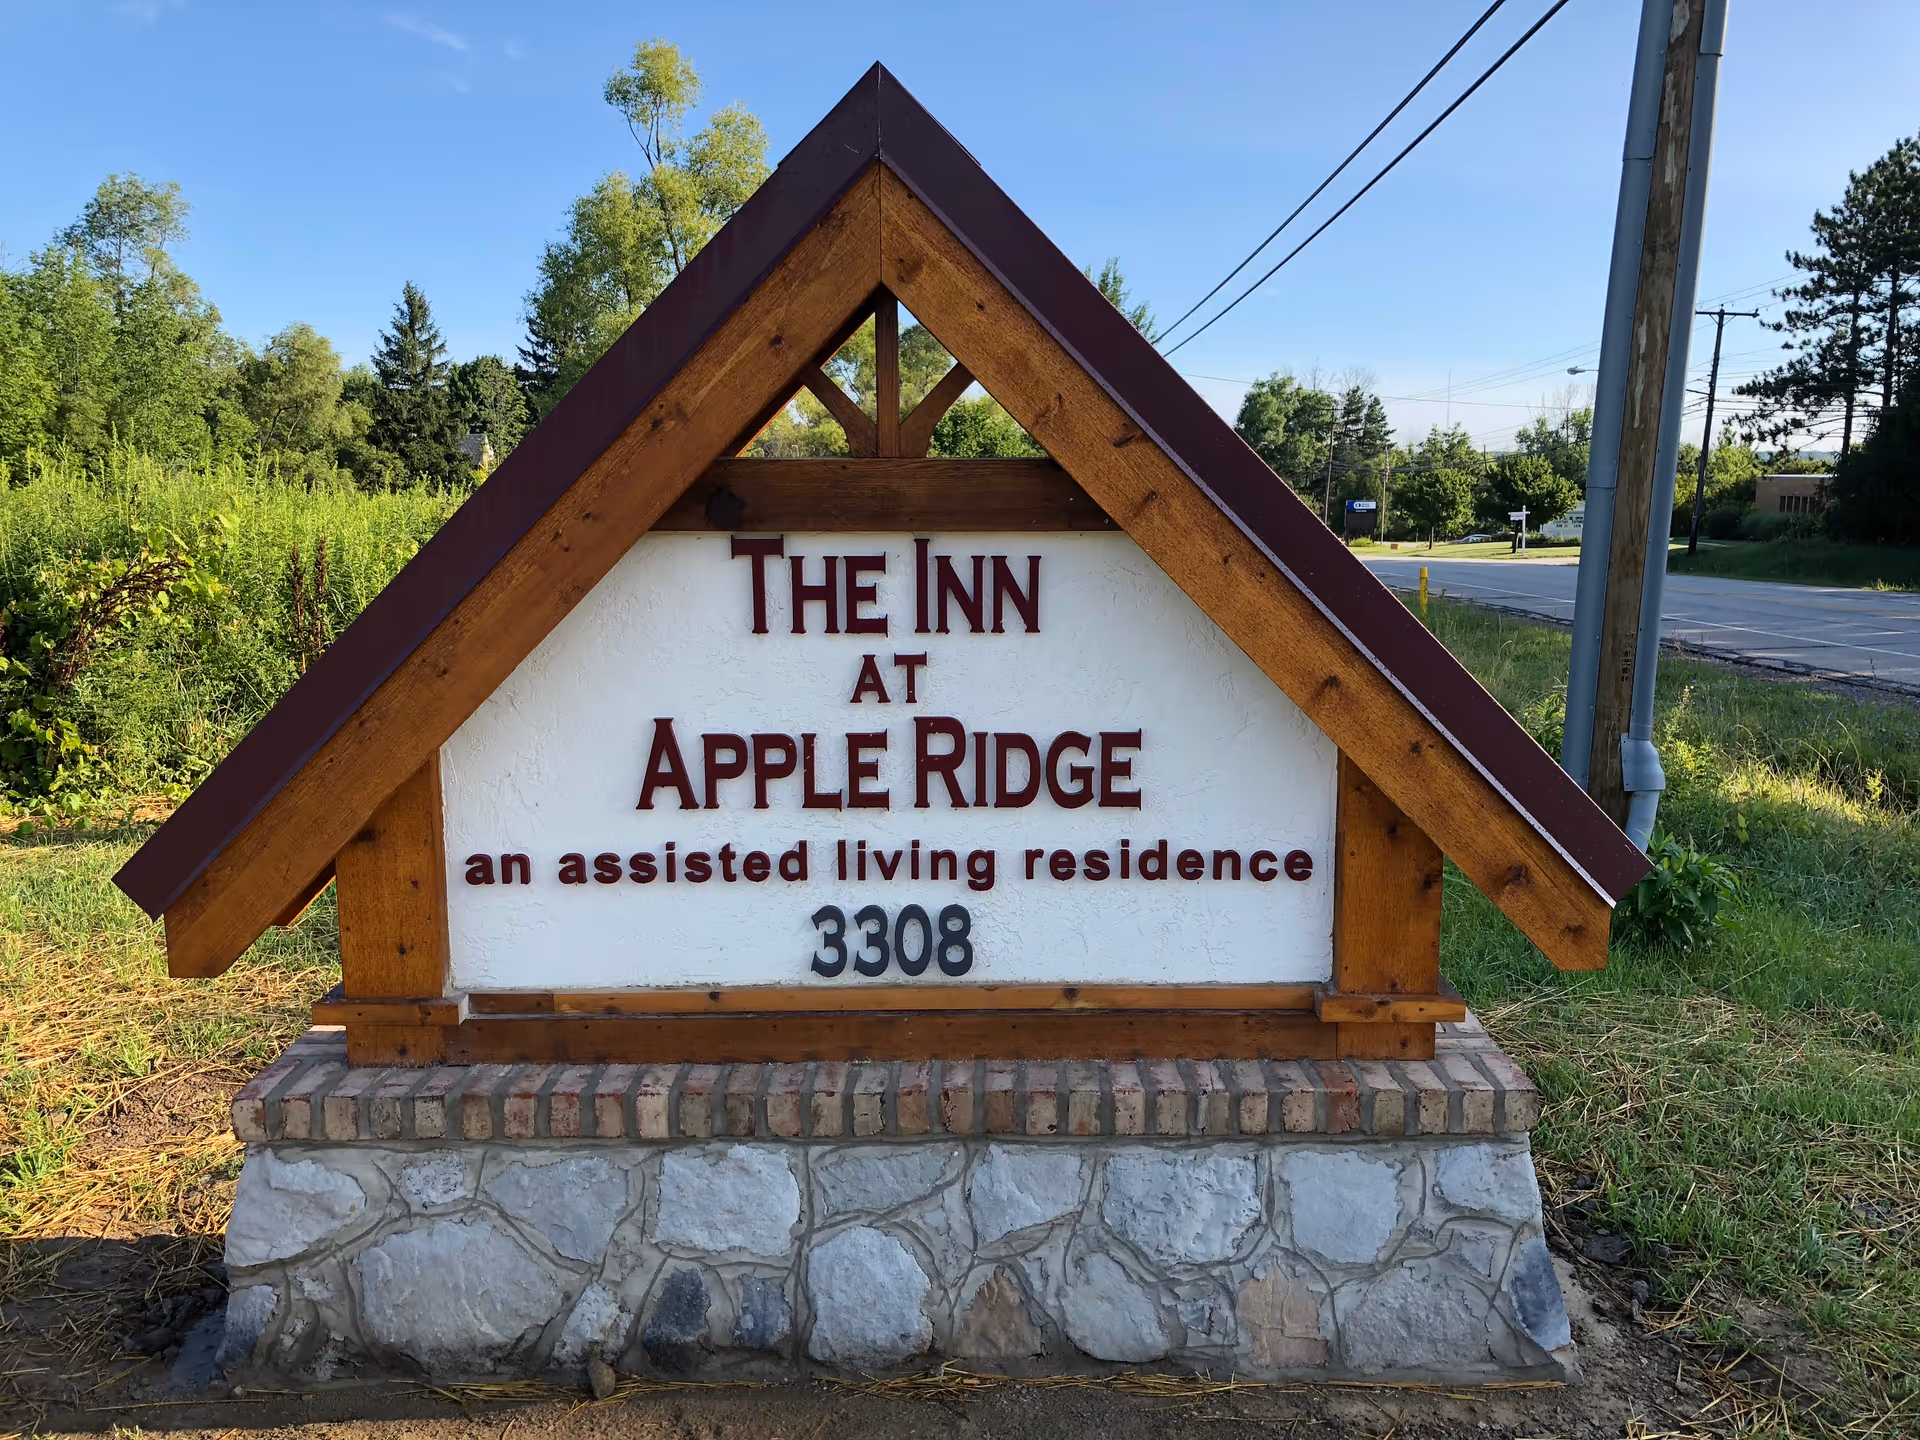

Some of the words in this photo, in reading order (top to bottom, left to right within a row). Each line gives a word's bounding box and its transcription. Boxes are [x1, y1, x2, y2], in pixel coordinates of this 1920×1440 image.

[732, 534, 889, 637] THE
[917, 538, 1042, 635] INN
[851, 654, 929, 704] AT
[635, 718, 890, 812] APPLE
[912, 713, 1142, 812] RIDGE
[464, 853, 531, 885] an
[558, 842, 808, 884] assisted
[837, 839, 993, 891] living
[1024, 839, 1314, 883] residence
[811, 904, 974, 978] 3308
